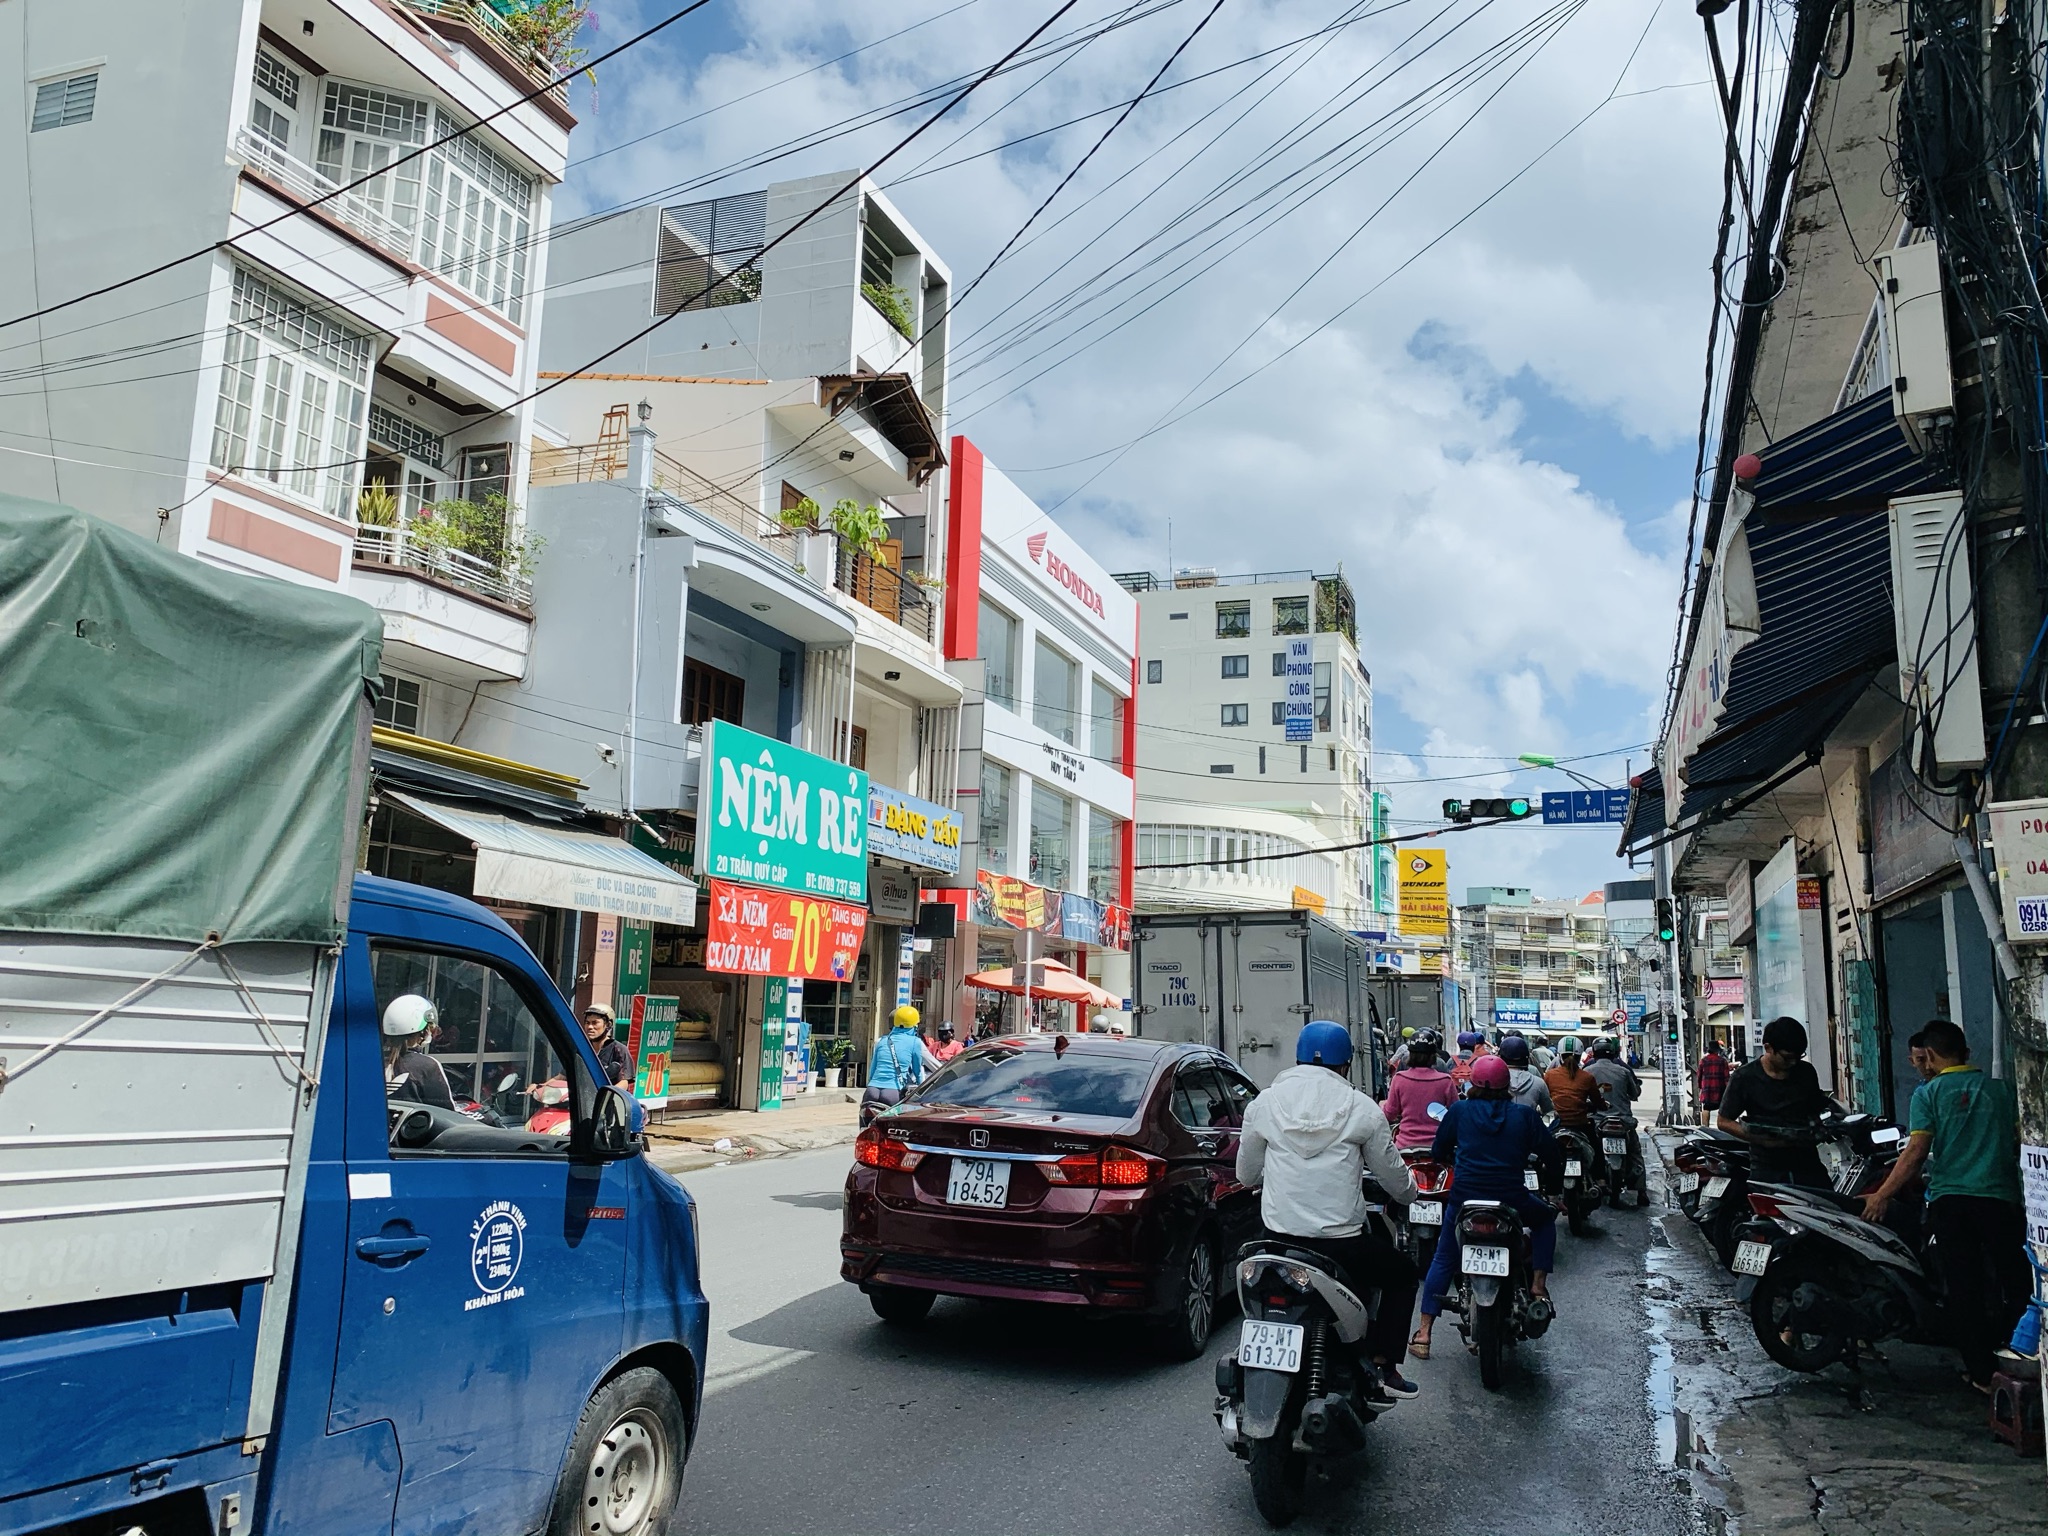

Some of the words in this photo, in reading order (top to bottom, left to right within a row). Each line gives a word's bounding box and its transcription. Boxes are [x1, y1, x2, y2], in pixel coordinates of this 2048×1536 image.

[1047, 549, 1105, 620] HONDA
[1292, 642, 1307, 656] VĂN
[1287, 661, 1312, 676] PHÒNG
[1289, 681, 1310, 696] CÔNG
[1287, 700, 1312, 716] CHỨNG
[718, 749, 809, 856] NỆM
[818, 772, 863, 858] RẺ
[1549, 810, 1557, 819] HÀ
[1576, 810, 1587, 820] CHỢ
[886, 801, 928, 839] ĐẶNG
[932, 814, 960, 849] TẤN
[716, 855, 727, 873] 20
[730, 854, 752, 877] TRẦN
[754, 861, 770, 880] QUÝ
[772, 863, 788, 884] CÁP
[624, 882, 636, 896] GIA
[637, 883, 657, 899] CÔNG
[806, 872, 817, 889] ĐT:
[818, 874, 834, 892] 0789
[836, 878, 849, 896] 737
[849, 881, 861, 897] 559
[653, 905, 673, 919] TRANG
[718, 888, 737, 924] XẢ
[741, 894, 769, 933] NỆM
[1401, 902, 1417, 911] HẢI
[2019, 903, 2048, 922] 0914
[832, 907, 850, 926] TẶNG
[601, 929, 614, 943] 22
[772, 921, 794, 941] Giảm
[841, 930, 857, 948] MÓN
[628, 940, 643, 975] RẺ
[708, 932, 742, 969] CUỐI
[742, 939, 771, 972] NĂM
[769, 979, 783, 1004] CẤP
[1168, 976, 1189, 990] 79C
[1498, 1011, 1516, 1021] VIỆT
[1517, 1011, 1537, 1021] PHÁT
[647, 1030, 659, 1047] CAO
[659, 1025, 671, 1047] CẤP
[767, 1013, 782, 1040] NỆM
[762, 1045, 773, 1069] GIÁ
[762, 1077, 770, 1102] VÀ
[771, 1076, 780, 1101] LẺ
[965, 1160, 994, 1183] 79A
[951, 1181, 1004, 1206] 184.52
[480, 1200, 510, 1221] THÀNH
[511, 1204, 527, 1231] VINH
[491, 1222, 513, 1237] 1220kg
[492, 1243, 511, 1257] 990kg
[1470, 1247, 1501, 1260] 79-N1
[1741, 1245, 1765, 1257] 79-N1
[489, 1263, 512, 1279] 2340kg
[1465, 1260, 1506, 1274] 750.26
[464, 1292, 501, 1312] KHÁNH
[504, 1286, 525, 1302] HÒA
[1251, 1324, 1293, 1347] 79-N1
[1243, 1344, 1297, 1368] 613.70
